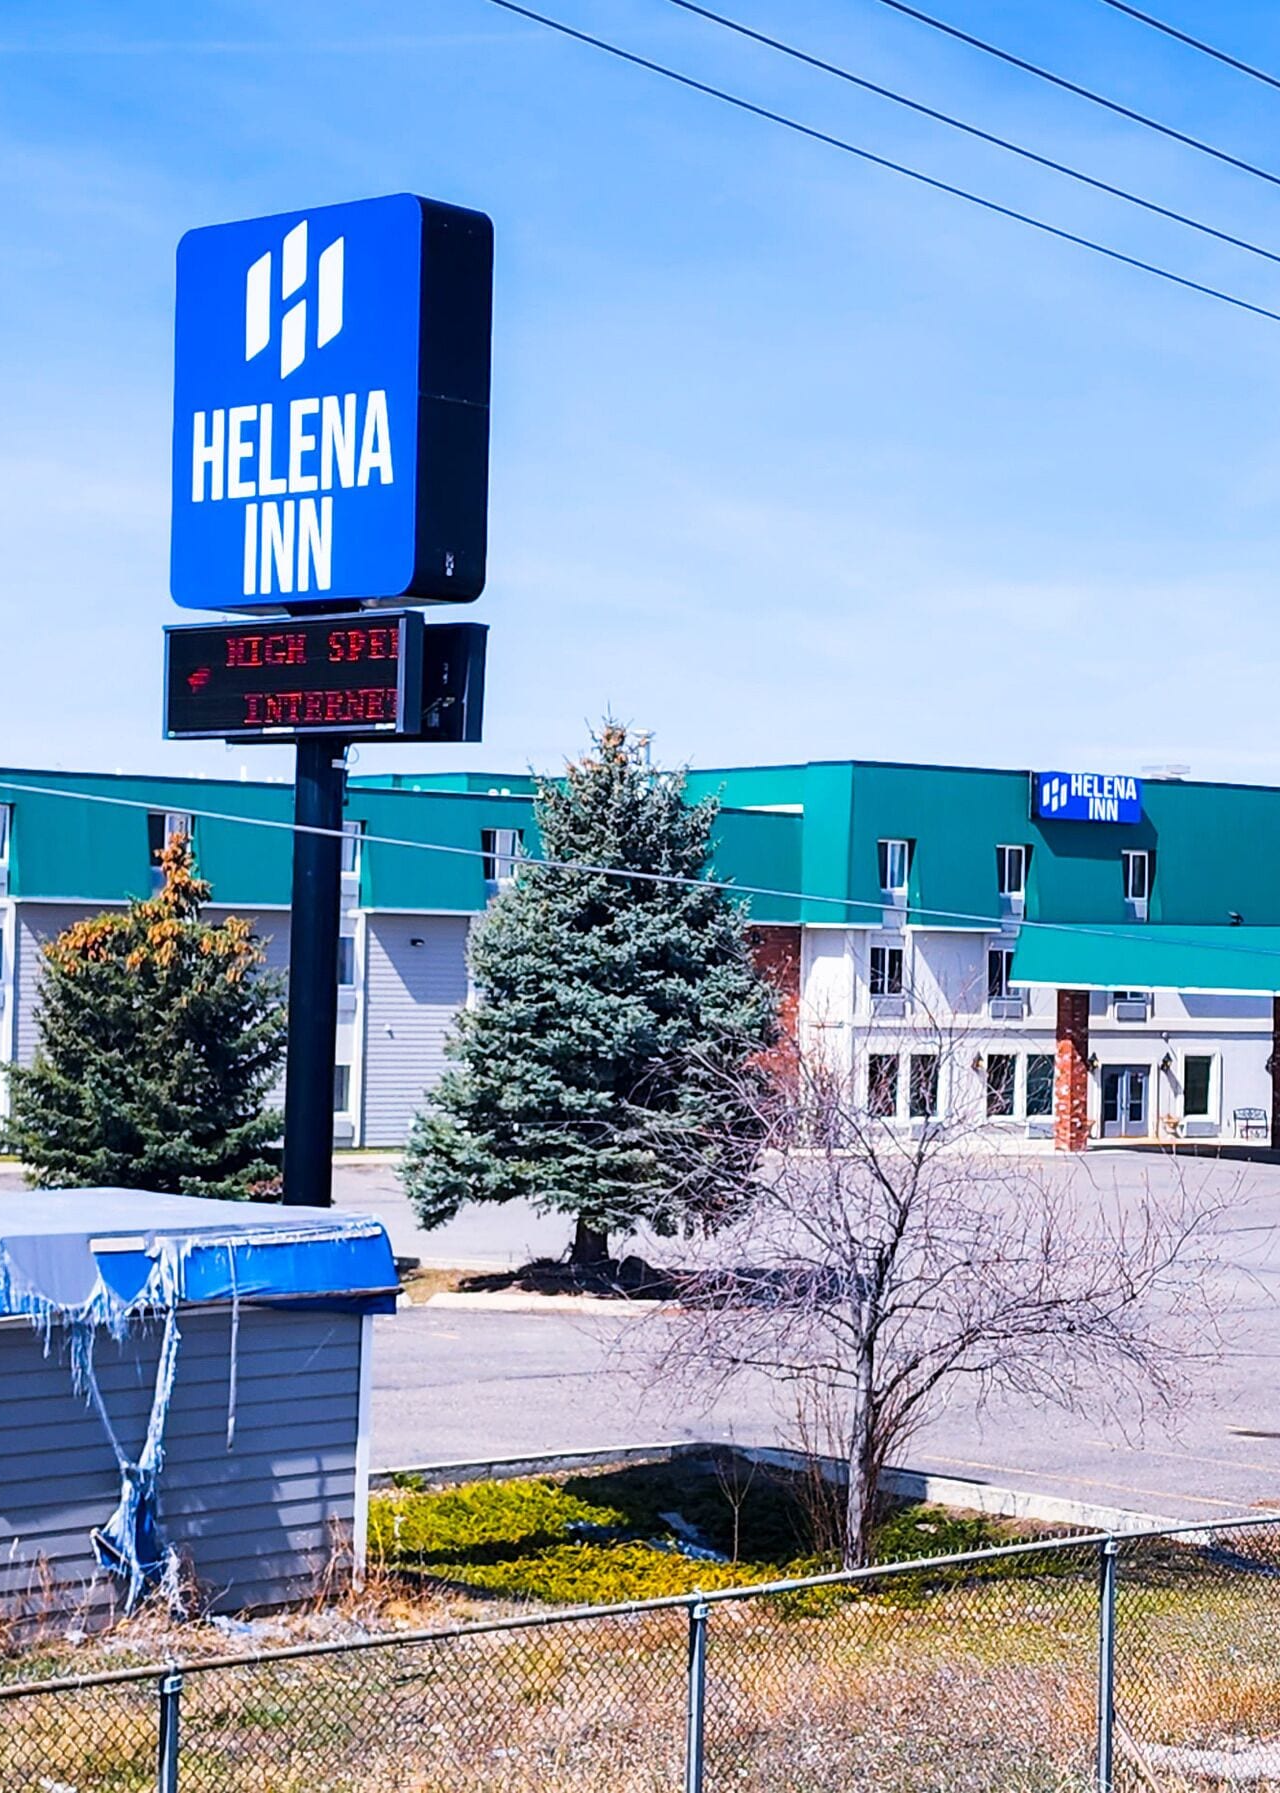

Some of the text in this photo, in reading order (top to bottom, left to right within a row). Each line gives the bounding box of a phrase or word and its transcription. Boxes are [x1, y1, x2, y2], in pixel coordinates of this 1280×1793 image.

[192, 390, 393, 502] HELENA
[243, 497, 333, 595] INN
[226, 634, 306, 667] HIGH
[1071, 774, 1137, 801] HELENA
[1089, 797, 1118, 821] INN
